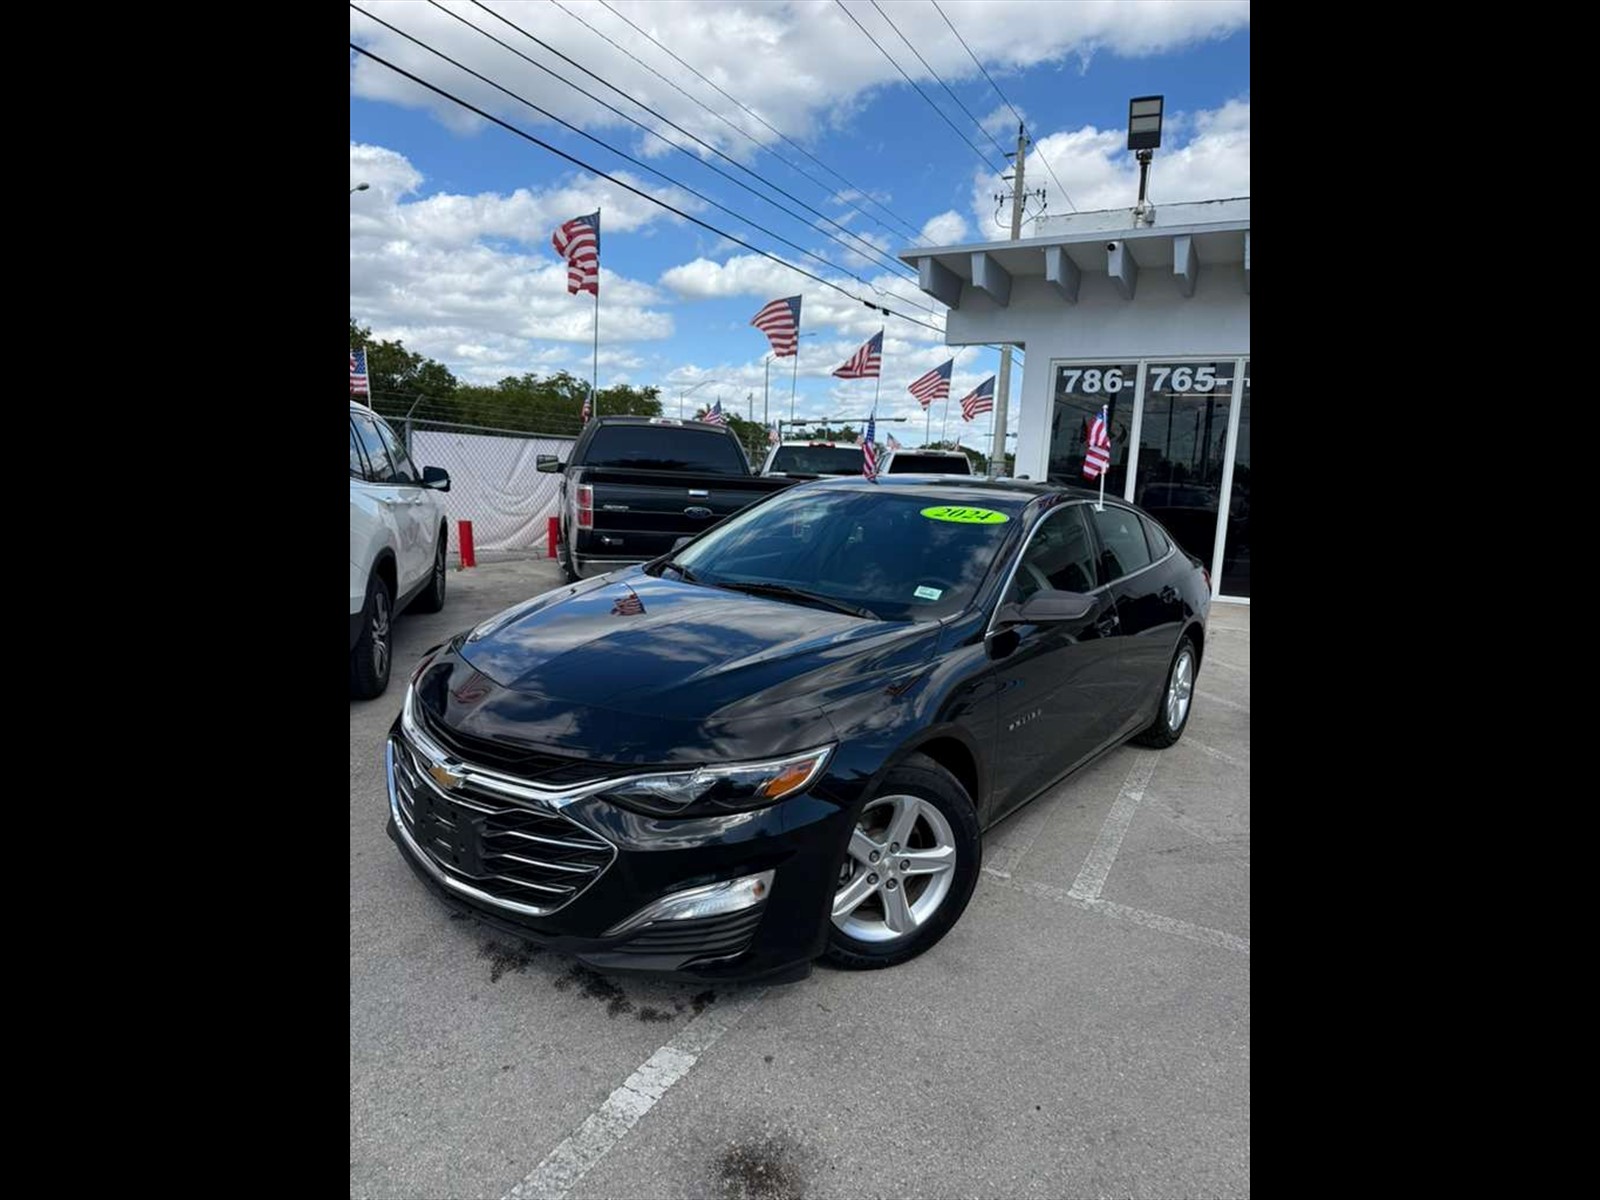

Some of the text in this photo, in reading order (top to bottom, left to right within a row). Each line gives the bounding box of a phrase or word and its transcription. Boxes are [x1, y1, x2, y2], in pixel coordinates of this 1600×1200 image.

[1062, 369, 1135, 393] 786-
[1150, 367, 1228, 392] 765-
[934, 507, 993, 521] 2024
